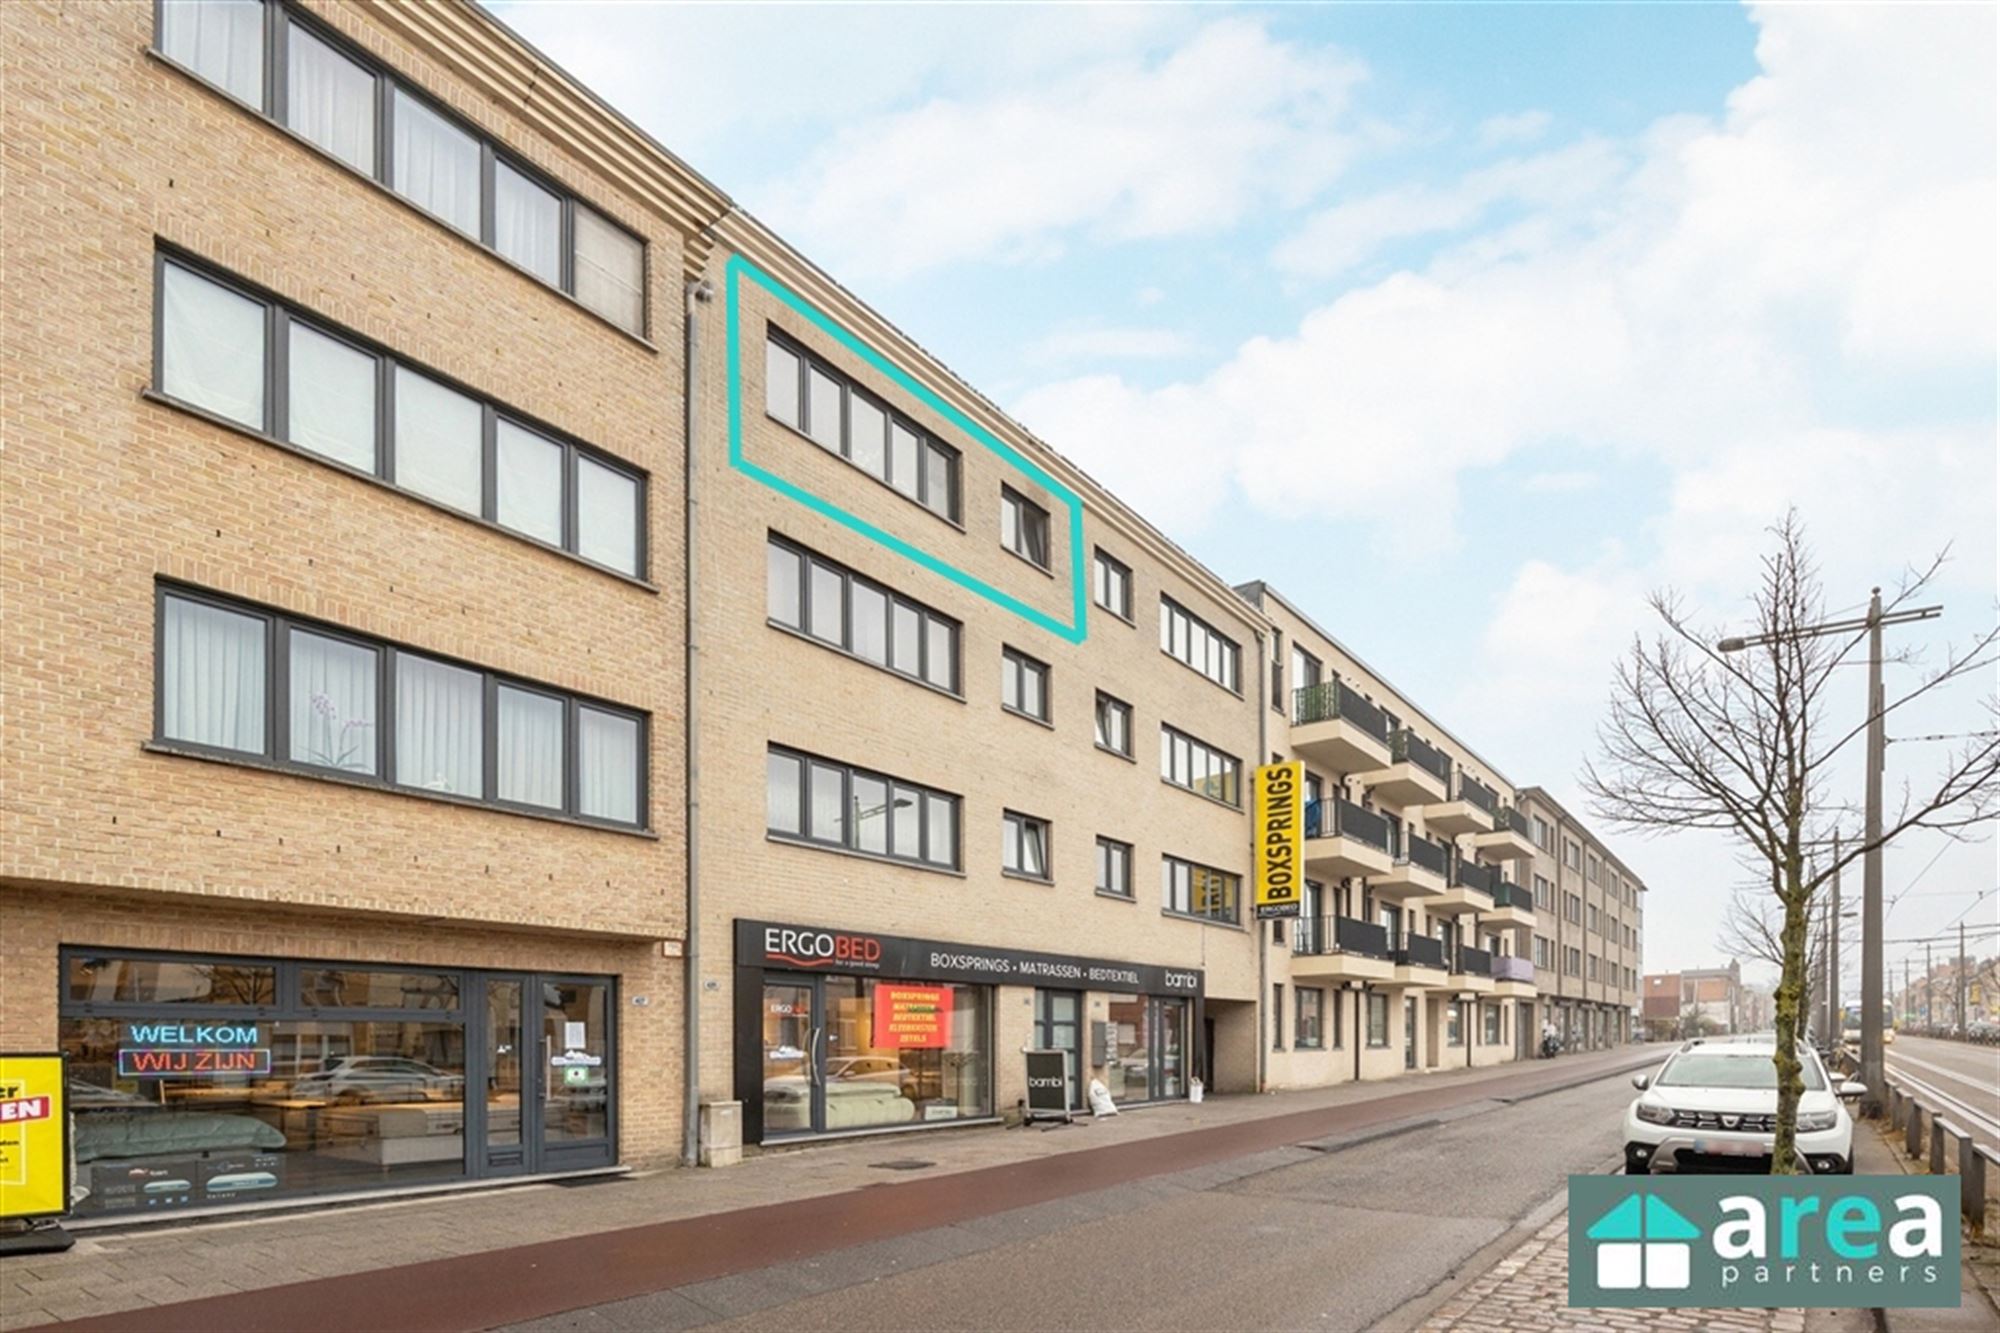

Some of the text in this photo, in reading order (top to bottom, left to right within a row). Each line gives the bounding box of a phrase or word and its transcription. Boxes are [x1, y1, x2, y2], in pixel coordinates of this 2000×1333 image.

[1266, 766, 1293, 900] BOXSPRINGS
[764, 927, 881, 962] ERGOBED
[930, 952, 1139, 984] BOXSPRINGS MATRASSEN BEDTEXTIEL
[1164, 969, 1198, 988] bambi
[130, 1025, 258, 1044] WELKOM
[132, 1052, 256, 1071] WIJ ZIJN
[1028, 1076, 1063, 1088] bambi
